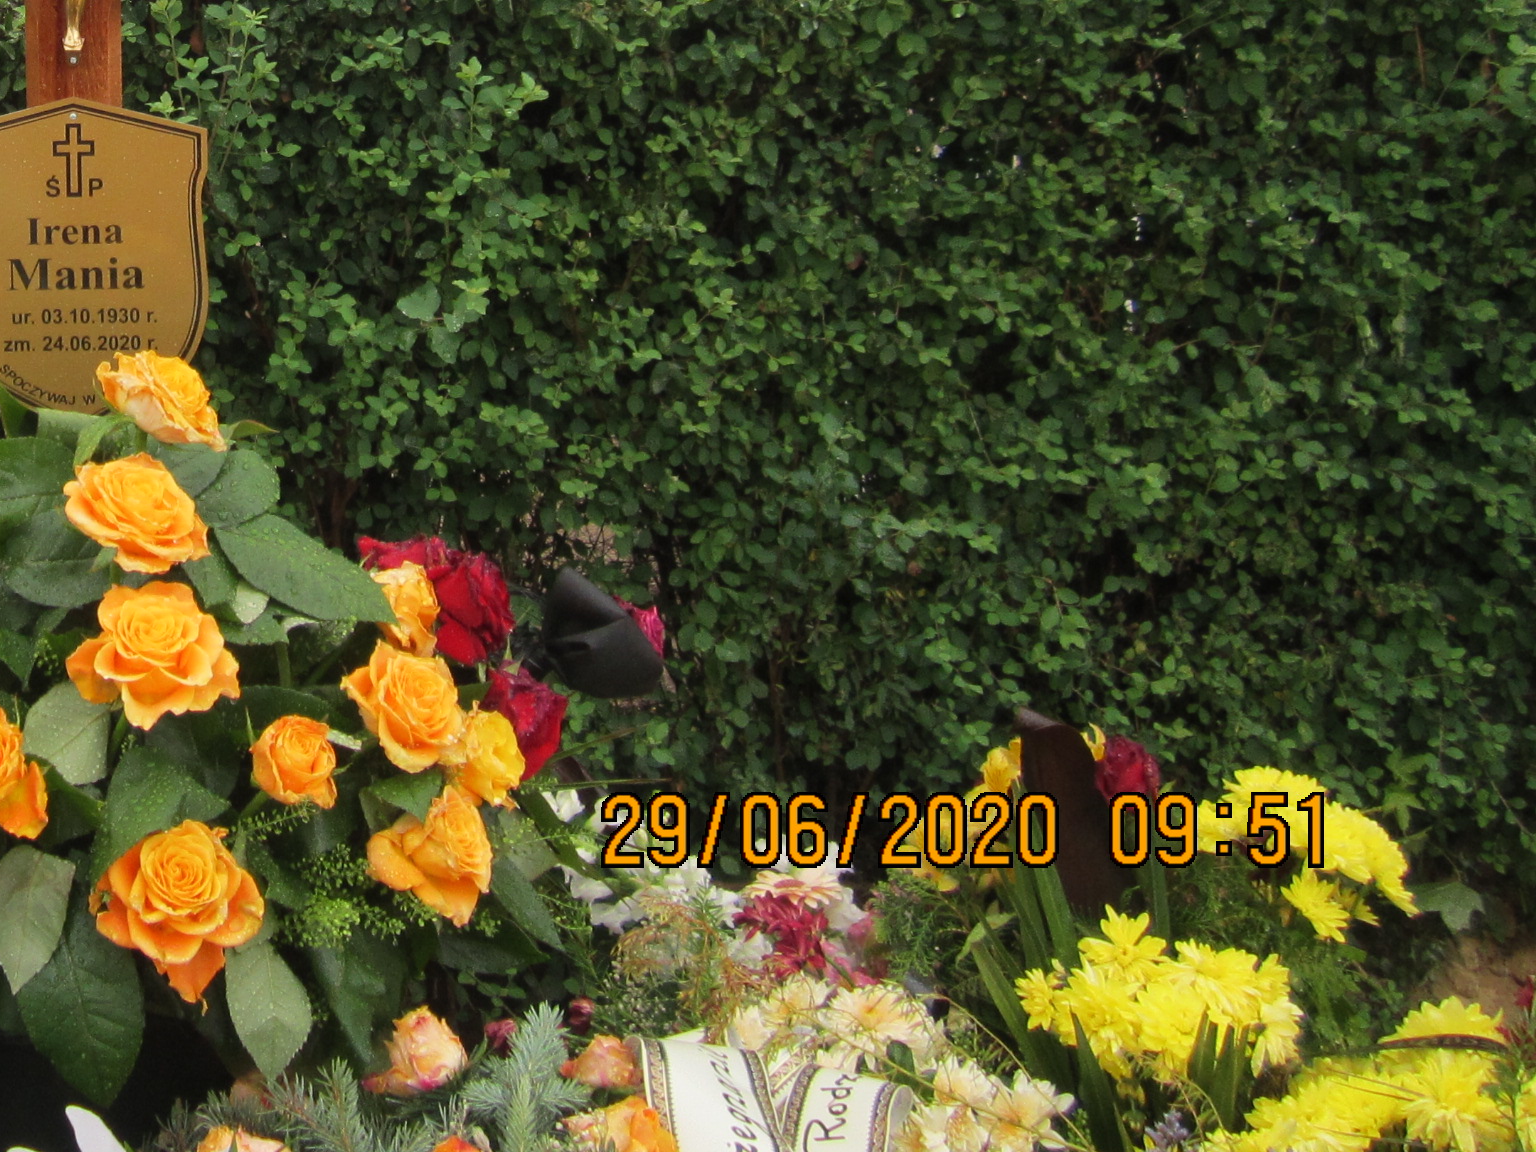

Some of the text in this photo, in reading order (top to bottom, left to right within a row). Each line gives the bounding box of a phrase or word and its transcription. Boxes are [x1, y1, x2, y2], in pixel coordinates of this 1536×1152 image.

[46, 175, 104, 197] Ś P
[27, 218, 124, 246] Irena
[7, 257, 145, 291] Mania
[12, 308, 158, 325] ur. 03.10.1930 r.
[3, 335, 158, 352] zm. 24.06.2020 r.
[0, 364, 96, 406] SPOCZYWAJ W
